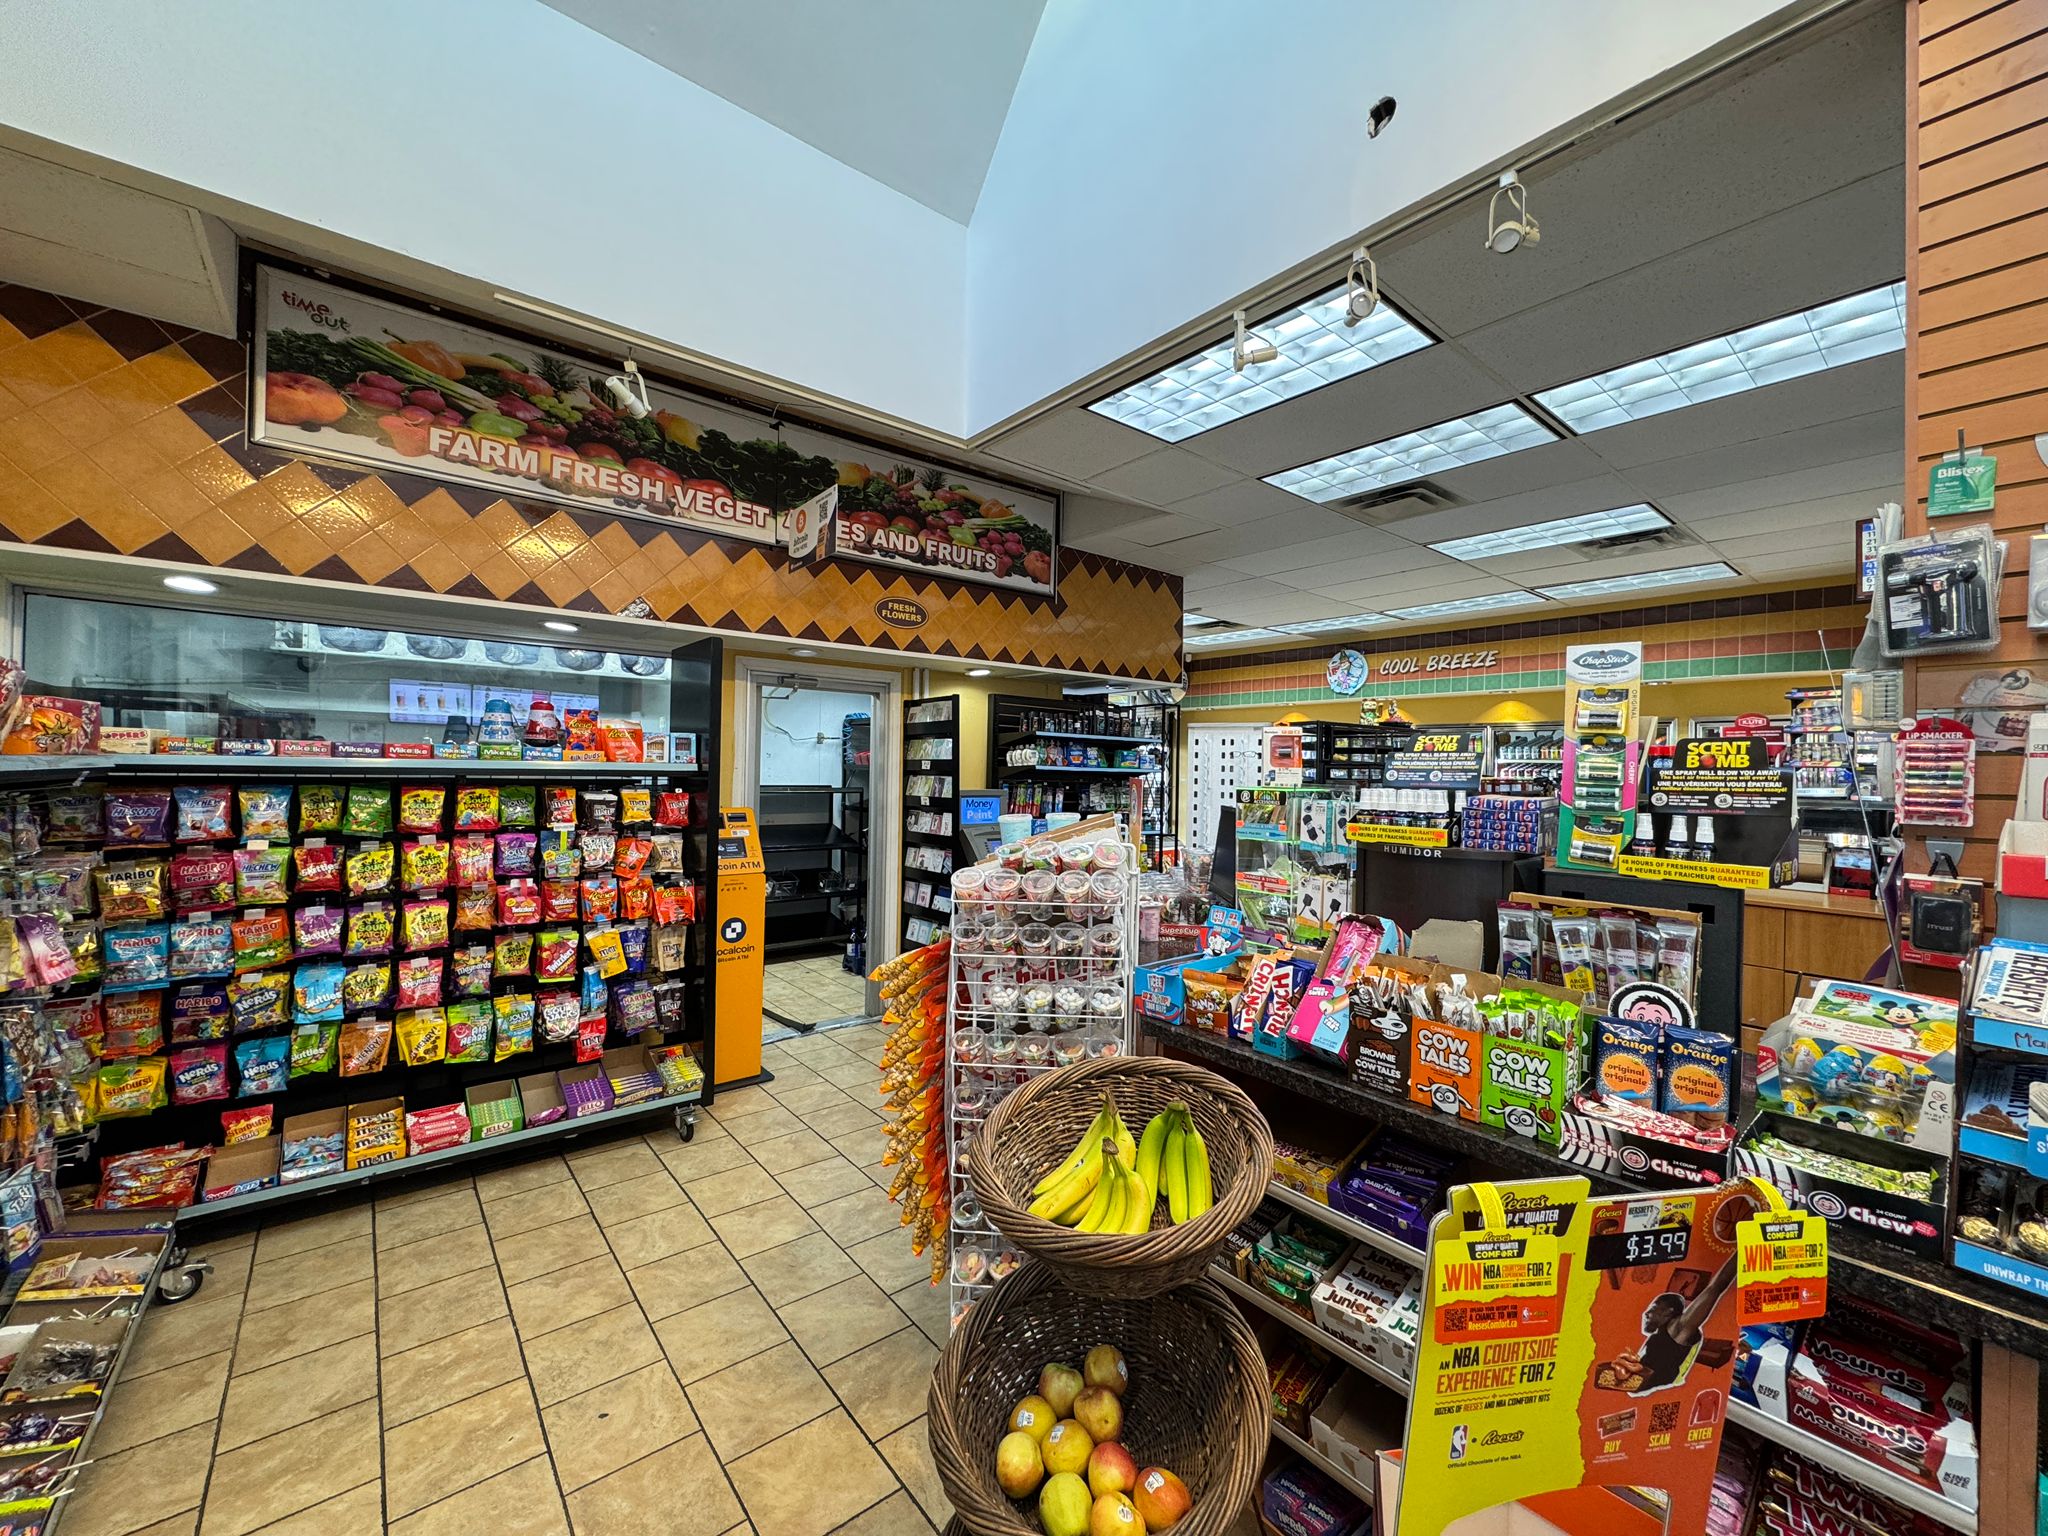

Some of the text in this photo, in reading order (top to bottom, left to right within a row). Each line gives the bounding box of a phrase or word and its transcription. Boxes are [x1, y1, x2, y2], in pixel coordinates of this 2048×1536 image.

[310, 313, 349, 332] out
[1937, 465, 1985, 478] Blistex
[430, 427, 539, 474] FARM
[551, 455, 664, 502] FRESH
[872, 528, 920, 554] AND
[925, 539, 998, 571] FRUITS
[888, 601, 916, 613] FRESH
[881, 609, 922, 622] FLOWERS
[1380, 649, 1499, 676] COOL BREEZE
[1579, 654, 1631, 667] ChapStick
[1630, 689, 1638, 720] ORIGINAL
[1416, 735, 1461, 744] SCENT
[1921, 731, 1963, 739] SMACKER
[224, 741, 270, 750] Mike Ike
[285, 744, 309, 752] Mike
[389, 746, 428, 755] Mike Ike
[1688, 741, 1751, 755] SCENT
[584, 752, 600, 760] Duds
[1628, 761, 1636, 785] CHERRY
[966, 799, 993, 809] Money
[112, 806, 160, 817] HI-SOFT
[967, 811, 992, 819] Point
[1384, 845, 1442, 858] HUMIDOR
[180, 862, 228, 875] HARIBO
[416, 858, 441, 868] SOUR
[740, 861, 761, 869] ATM
[105, 869, 154, 883] HARIBO
[301, 863, 340, 878] Skittles
[1634, 867, 1662, 875] HEURES
[1674, 871, 1715, 881] FRAICHEUR
[1717, 875, 1759, 885] GARANTIE!
[1666, 863, 1708, 872] FRESHNESS
[1710, 867, 1764, 878] GUARANTEED!
[589, 891, 616, 900] Reese's
[663, 890, 691, 898] Reese's
[177, 927, 224, 938] HARIBO
[238, 923, 278, 936] HARIBO
[358, 924, 387, 932] SOUR
[112, 936, 161, 948] HARIBO
[717, 944, 755, 956] ocalcoin
[737, 954, 749, 962] ATM
[457, 961, 492, 975] Maynards
[1999, 952, 2048, 1013] HERSHEY'S
[176, 997, 222, 1009] HARIBO
[237, 991, 277, 1011] Nerds
[623, 992, 652, 1004] HARIBO
[1192, 999, 1219, 1011] PANDA
[111, 1006, 150, 1016] HARIBO
[471, 1025, 487, 1034] AIR
[1430, 1025, 1455, 1036] CARAMEL
[460, 1034, 487, 1047] HEADS
[1417, 1029, 1469, 1056] COW
[1602, 1032, 1655, 1055] Orange
[1360, 1046, 1396, 1063] BROWNIE
[1416, 1044, 1471, 1075] TALES
[1671, 1042, 1728, 1066] Orange
[1490, 1047, 1550, 1076] COW
[179, 1063, 219, 1083] Nerds
[244, 1061, 279, 1080] Nerds
[1355, 1059, 1401, 1079] COW TALES
[1607, 1063, 1645, 1077] original
[1488, 1063, 1552, 1096] TALES
[1604, 1071, 1648, 1087] originale
[1677, 1075, 1717, 1089] original
[104, 1076, 154, 1097] Starburst
[668, 1079, 701, 1095] DOTS
[1673, 1083, 1720, 1100] originale
[227, 1116, 272, 1138] Starburst
[235, 1130, 259, 1143] minis
[1563, 1132, 1618, 1159] French
[1651, 1158, 1703, 1183] Chew
[1365, 1179, 1385, 1190] DAIRY
[1501, 1192, 1548, 1210] Reese's
[1525, 1209, 1559, 1222] QUARTER
[1596, 1201, 1692, 1219] Reese's HERSHEY'S OH HENRY!
[1884, 1211, 1907, 1220] COUNT
[1849, 1206, 1914, 1236] Chew
[1483, 1232, 1511, 1242] Reese's
[1767, 1231, 1799, 1240] COMFORT
[1625, 1231, 1687, 1262] $3.99
[1475, 1250, 1519, 1258] COMFORT
[1744, 1244, 1818, 1272] WIN NBA FOR
[1352, 1266, 1401, 1290] Junior
[1444, 1262, 1552, 1291] WIN NBA FOR 2
[1983, 1263, 2032, 1285] UNWRAP
[1323, 1289, 1373, 1313] Junior
[1475, 1312, 1498, 1321] CHANCE
[1468, 1319, 1518, 1331] ReesesComfort.ca
[1439, 1337, 1559, 1370] AN NBA COURTSIDE
[1812, 1339, 1927, 1394] Mounds
[1436, 1361, 1556, 1394] EXPERIENCE FOR 2
[1757, 1383, 1780, 1398] KING
[1434, 1393, 1550, 1416] DOZENS OF AND NBA COMFORT KITS
[1687, 1427, 1712, 1441] ENTER
[1794, 1402, 1883, 1455] Mounds
[1481, 1430, 1524, 1446] Reese's
[1649, 1433, 1671, 1447] SCAN
[1603, 1439, 1621, 1453] BUY
[1448, 1458, 1493, 1469] Official Chocolate
[1944, 1471, 1971, 1486] KING
[1280, 1478, 1306, 1498] Nerds
[1308, 1502, 1336, 1523] Nerds
